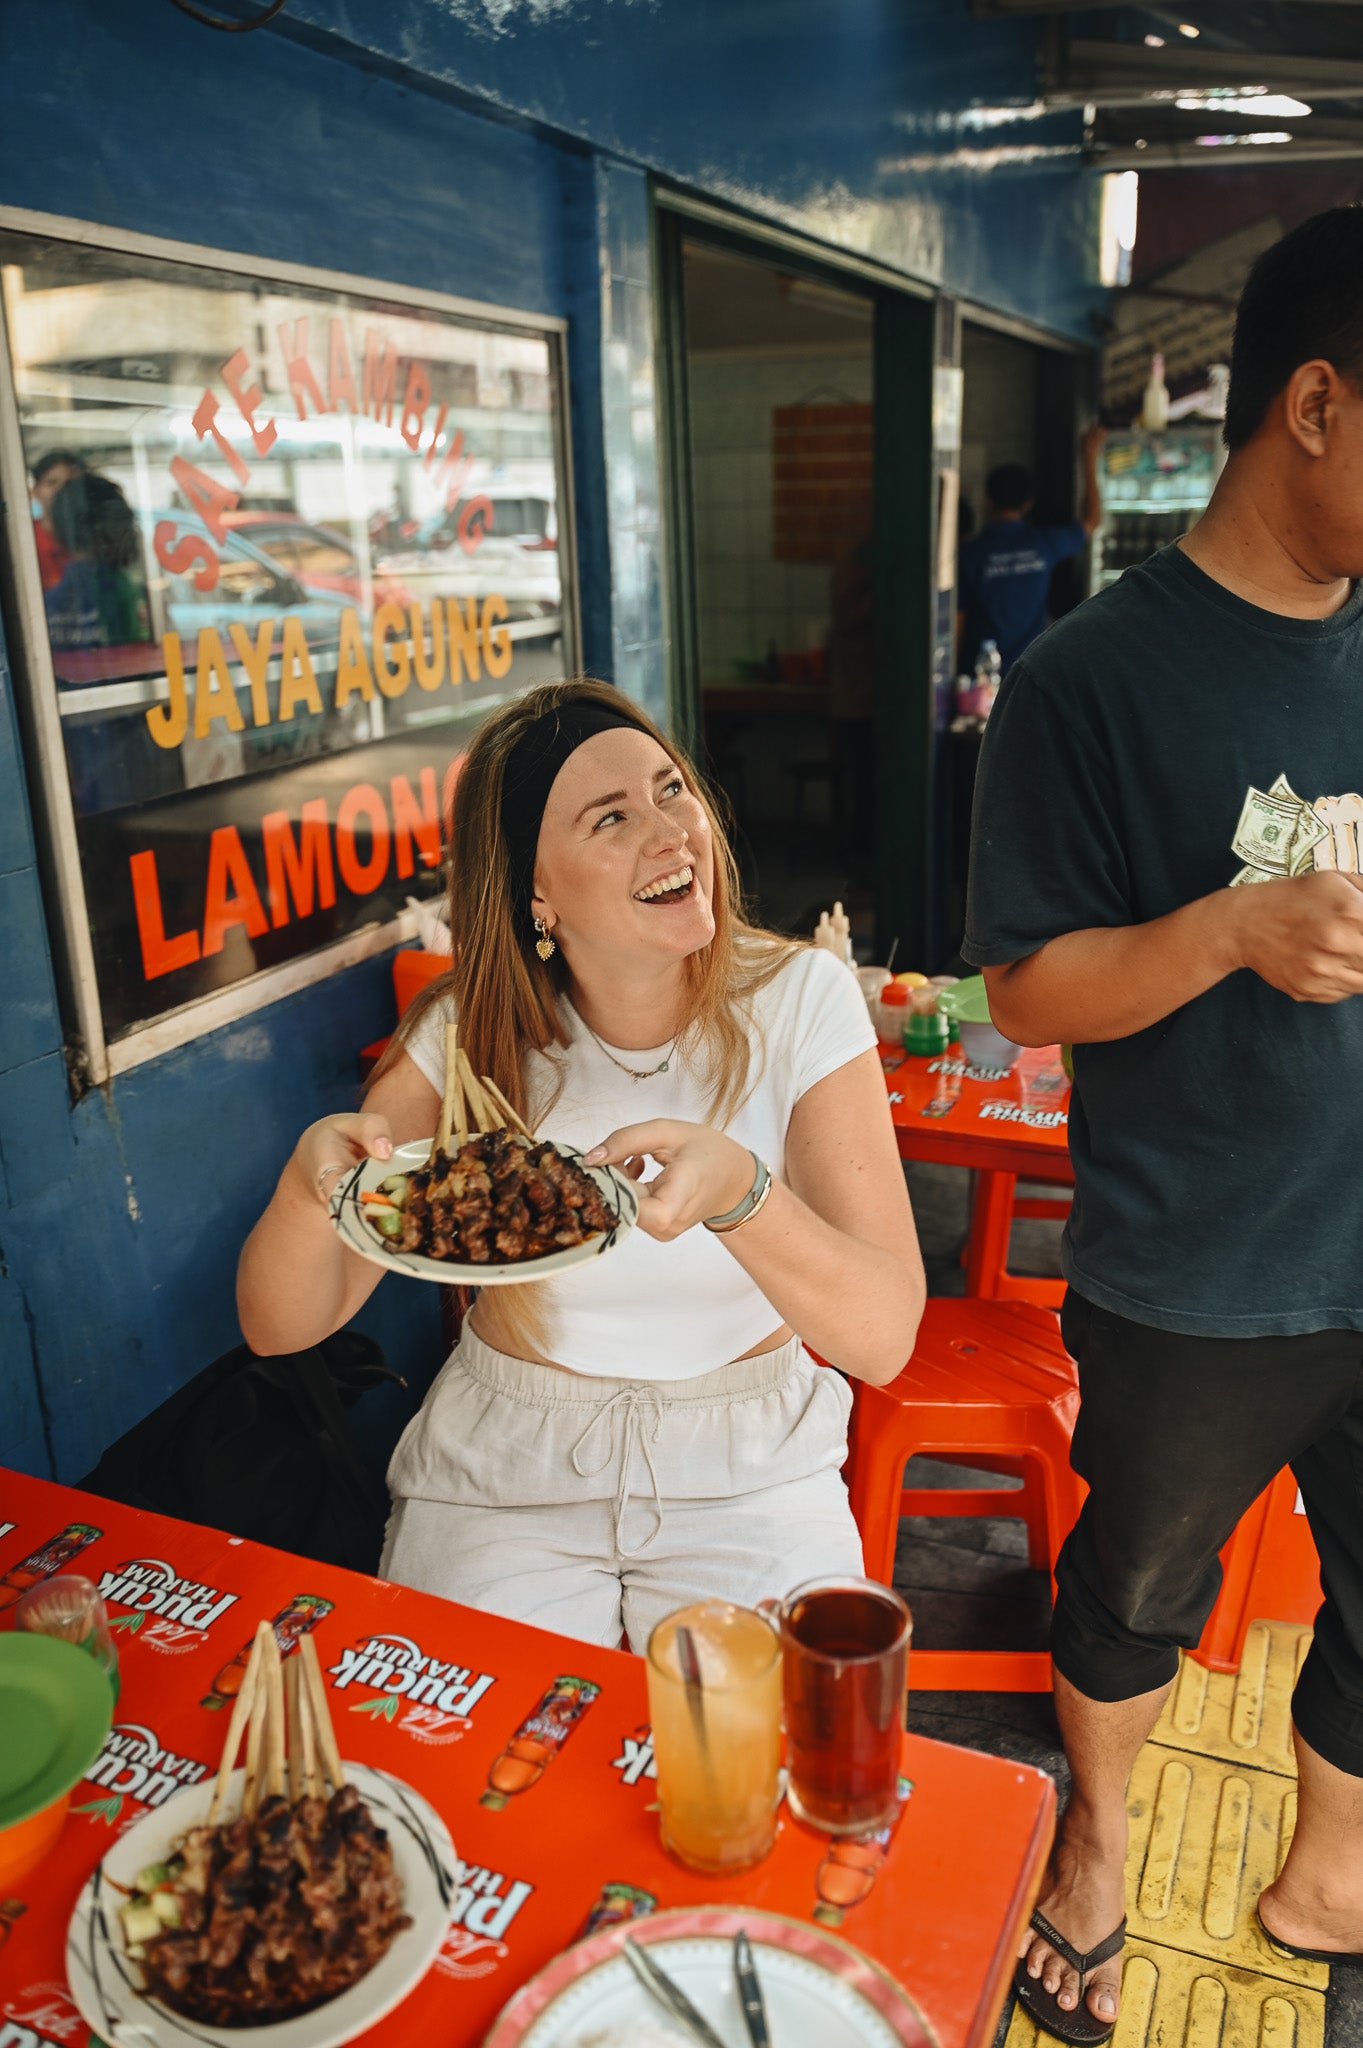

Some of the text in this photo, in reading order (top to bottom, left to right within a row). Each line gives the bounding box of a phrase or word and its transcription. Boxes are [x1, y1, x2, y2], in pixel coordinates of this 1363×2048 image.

[153, 318, 494, 592] SATE KAMBING
[146, 593, 513, 749] JAYA AGUNG
[117, 1558, 217, 1601] HARUM
[328, 1647, 496, 1717] pucuk
[357, 1633, 473, 1684] HARUM
